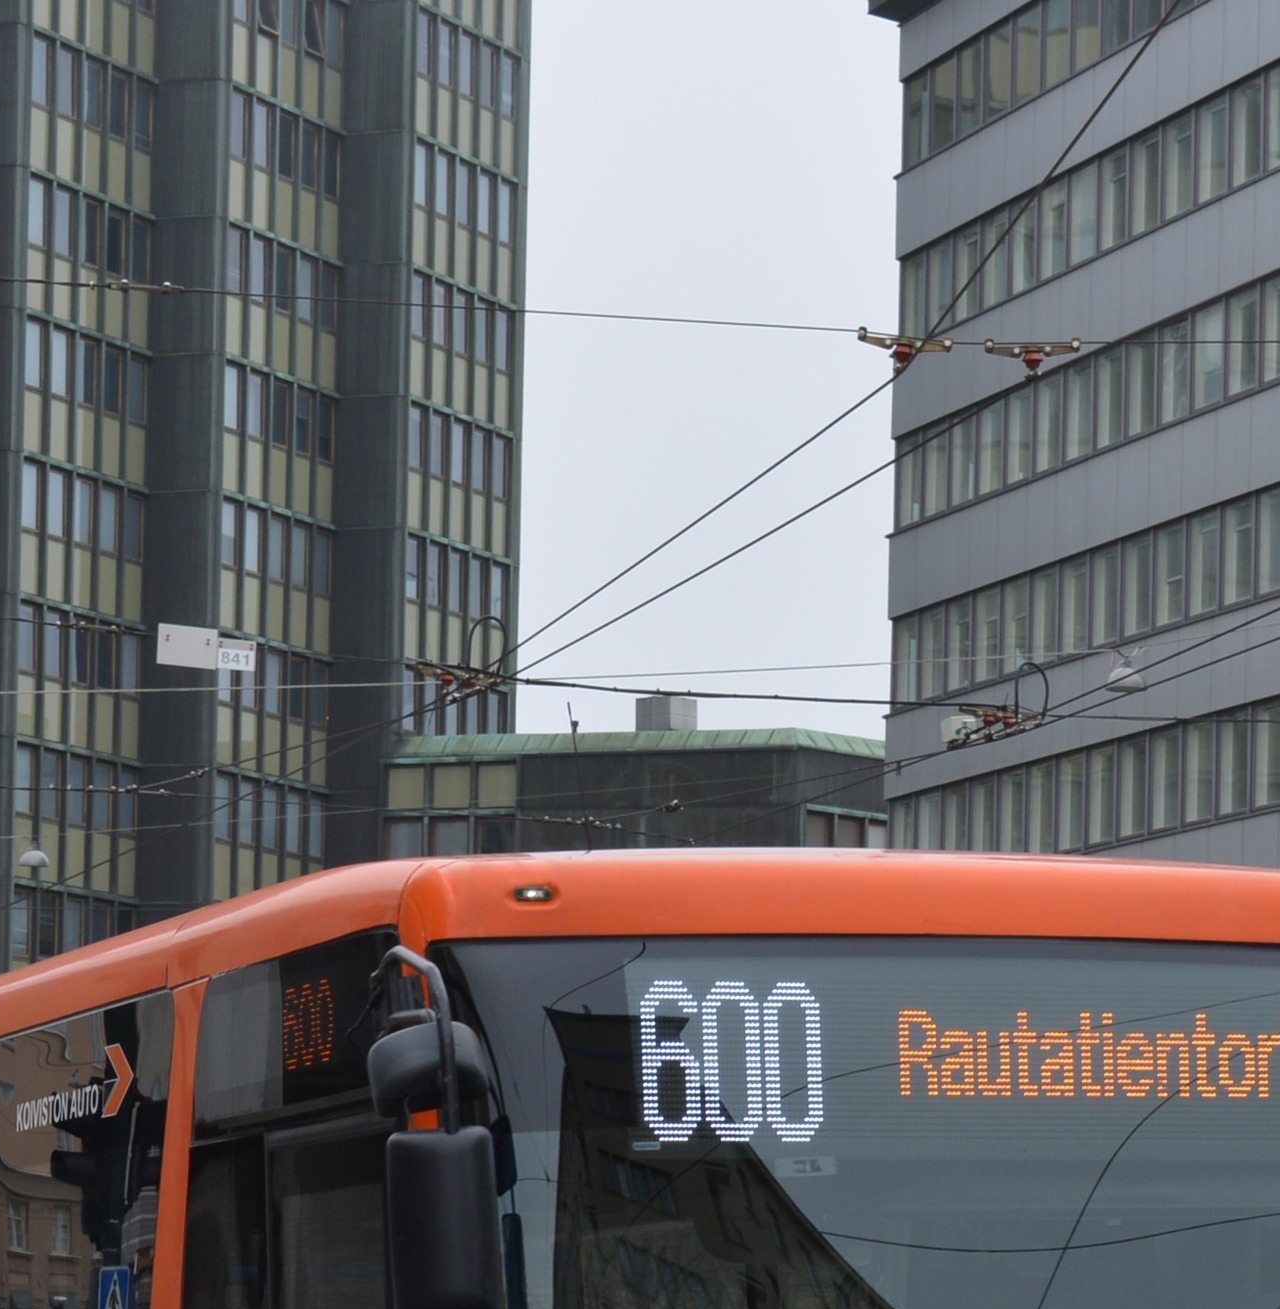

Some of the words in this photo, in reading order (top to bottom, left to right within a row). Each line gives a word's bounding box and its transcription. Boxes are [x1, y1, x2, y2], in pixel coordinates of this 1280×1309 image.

[220, 651, 250, 667] 841
[283, 978, 333, 1071] 600
[640, 980, 824, 1142] 600
[16, 1091, 68, 1132] KOIVISTON
[69, 1084, 99, 1119] AUTO
